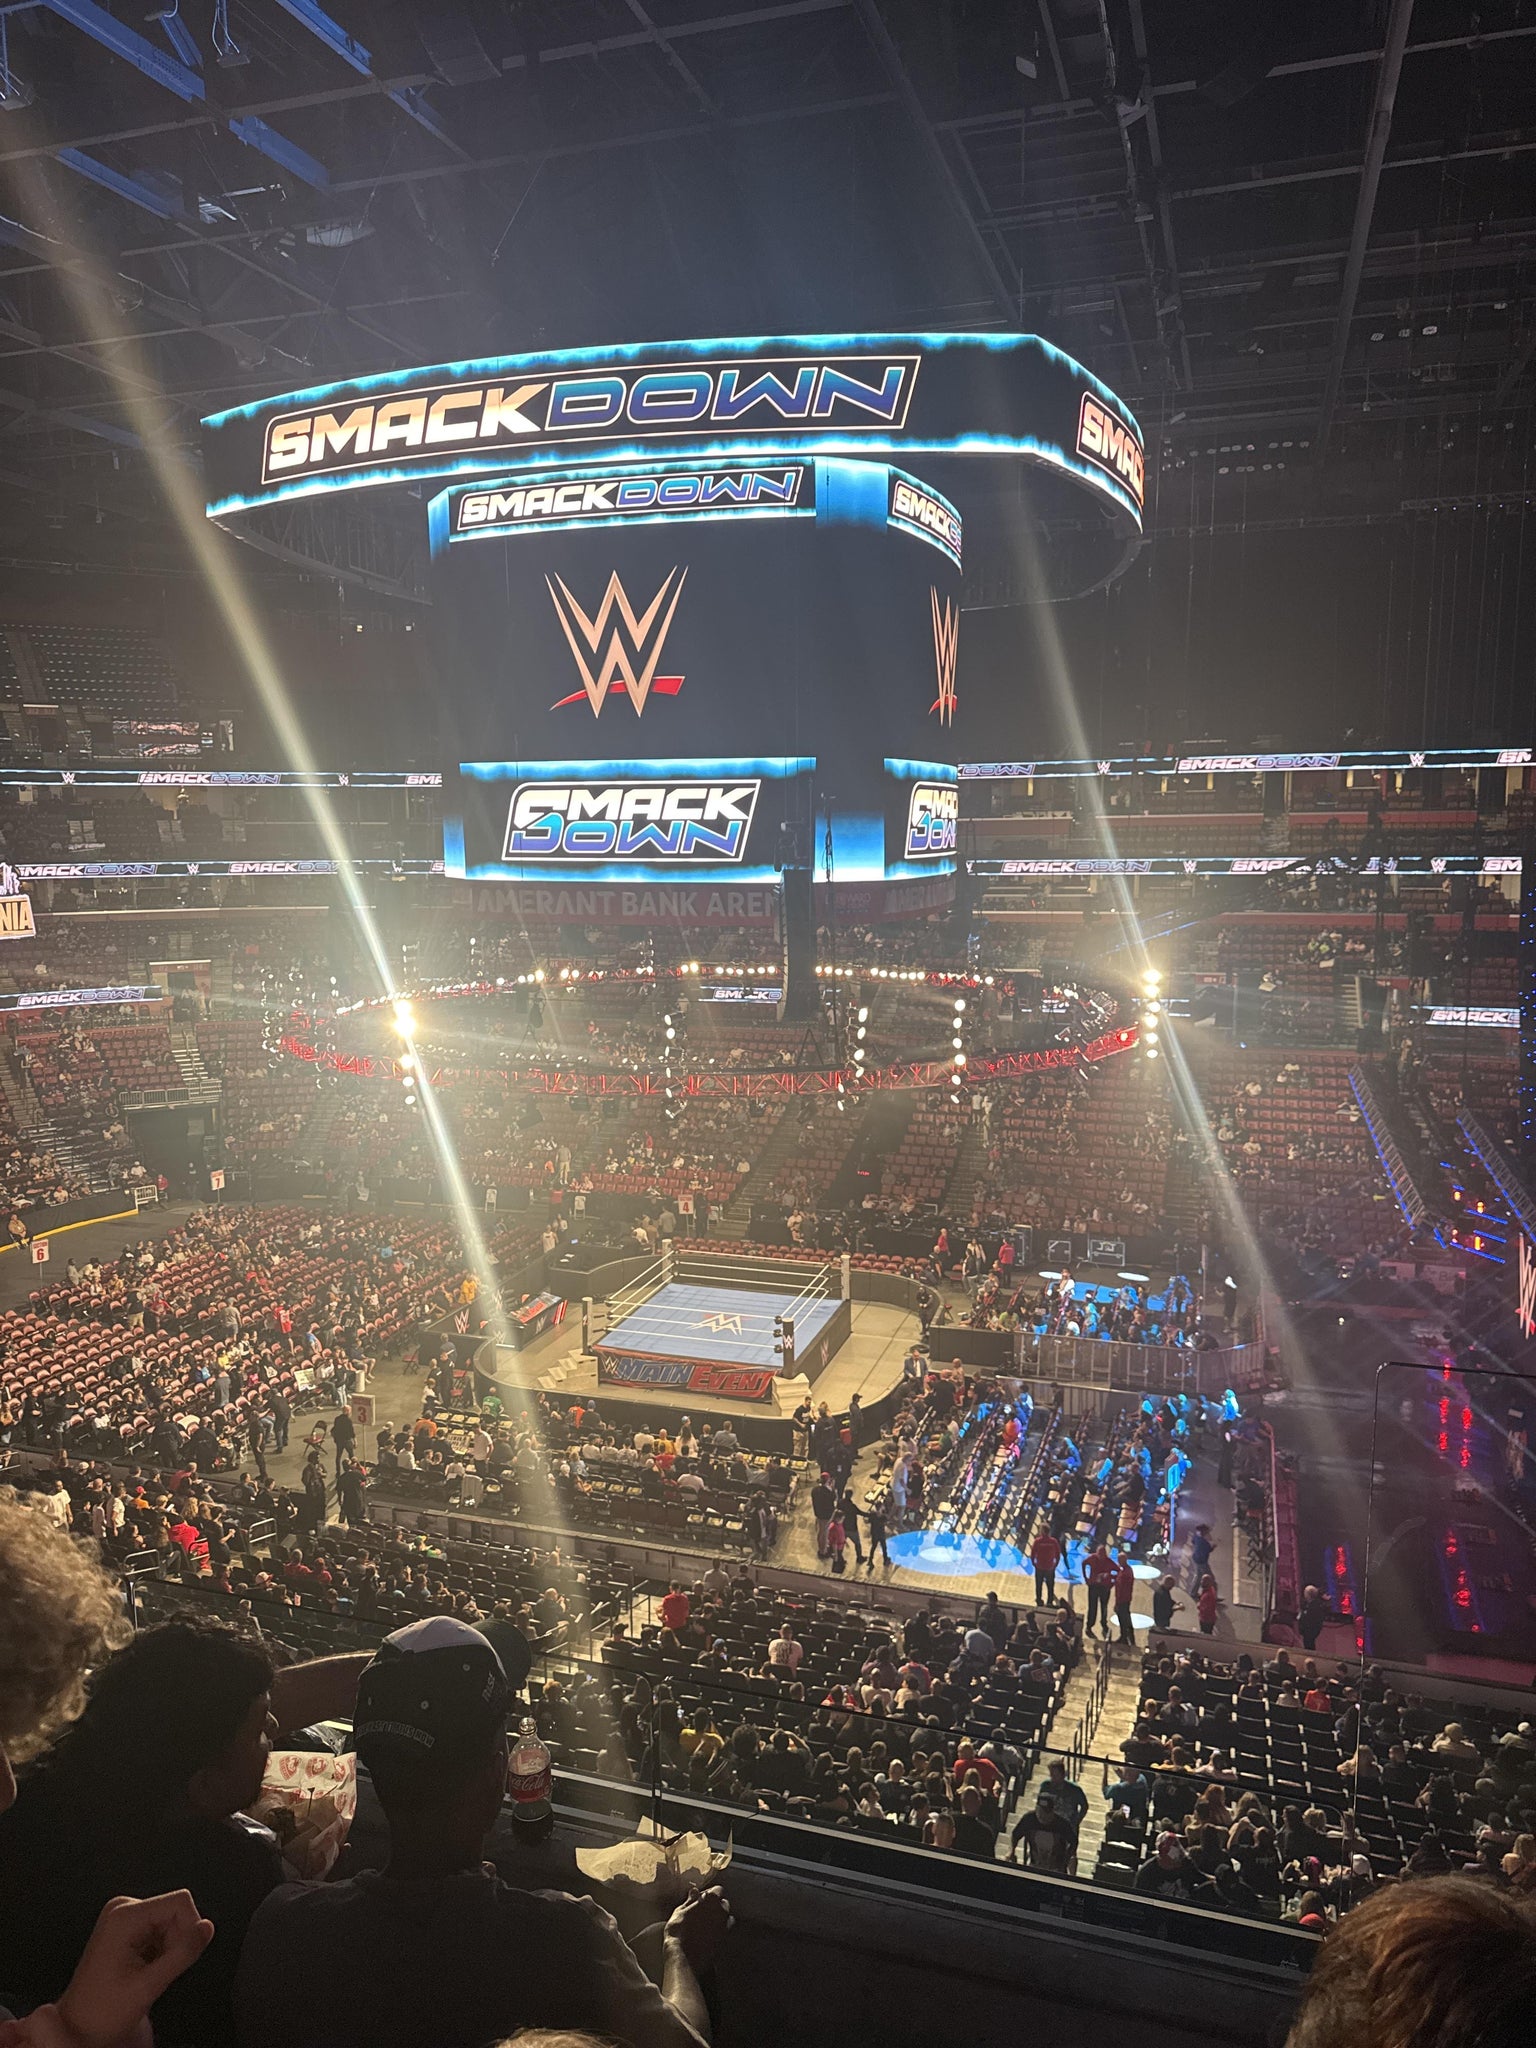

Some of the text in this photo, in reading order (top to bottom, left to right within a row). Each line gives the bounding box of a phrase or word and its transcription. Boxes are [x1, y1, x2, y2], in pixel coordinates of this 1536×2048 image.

[268, 366, 907, 471] SMACKDOWN
[461, 473, 797, 523] SMACKDOWN
[139, 773, 280, 784] SMACKDOWN
[1178, 755, 1338, 770] SMACKDOWN
[513, 788, 758, 828] SMACK
[509, 812, 743, 856] DOWN
[1003, 861, 1150, 873] SMACKDOWN
[476, 888, 780, 917] AMERANT BANK AREN
[20, 988, 143, 1006] SMACKDOWN
[616, 1357, 696, 1384] MAIN
[688, 1365, 777, 1392] EVENT
